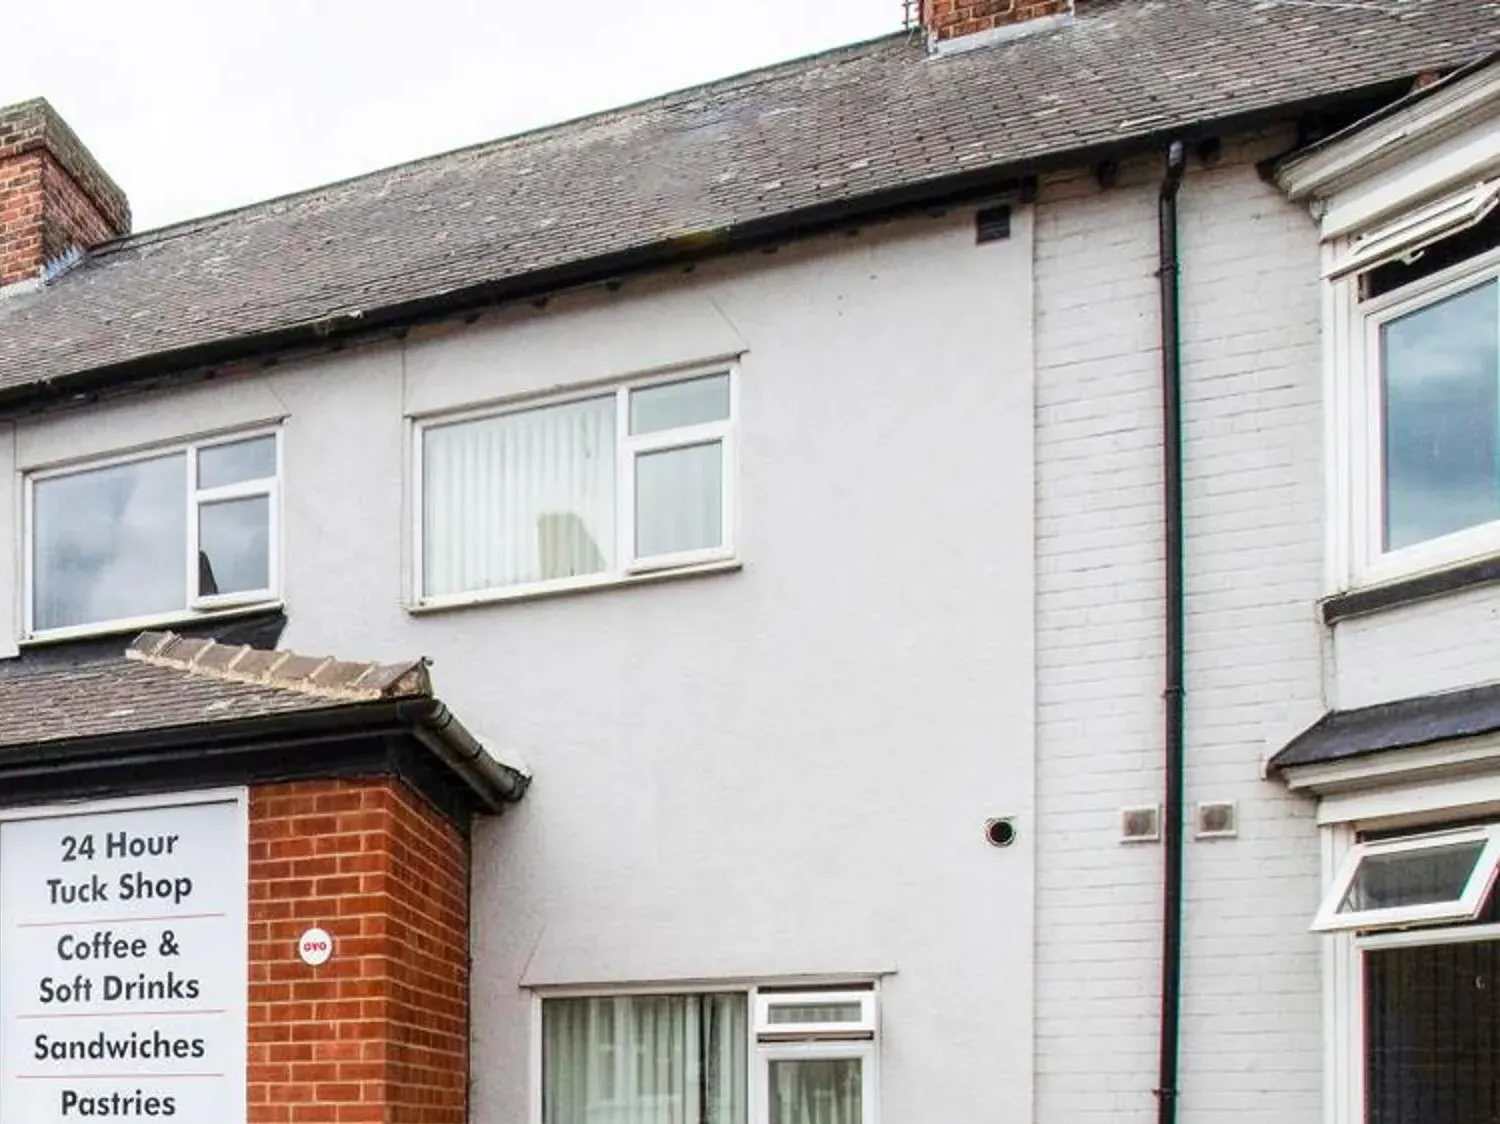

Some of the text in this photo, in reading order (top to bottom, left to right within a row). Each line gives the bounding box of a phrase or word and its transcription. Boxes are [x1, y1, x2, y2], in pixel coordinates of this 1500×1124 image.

[61, 831, 179, 862] 24 Hour
[46, 871, 192, 904] Tuck Shop
[57, 930, 180, 960] Coffee &
[303, 941, 327, 952] OYO
[39, 971, 200, 1003] Soft Drinks
[34, 1030, 205, 1060] Sandwiches
[61, 1089, 176, 1116] Pastries
